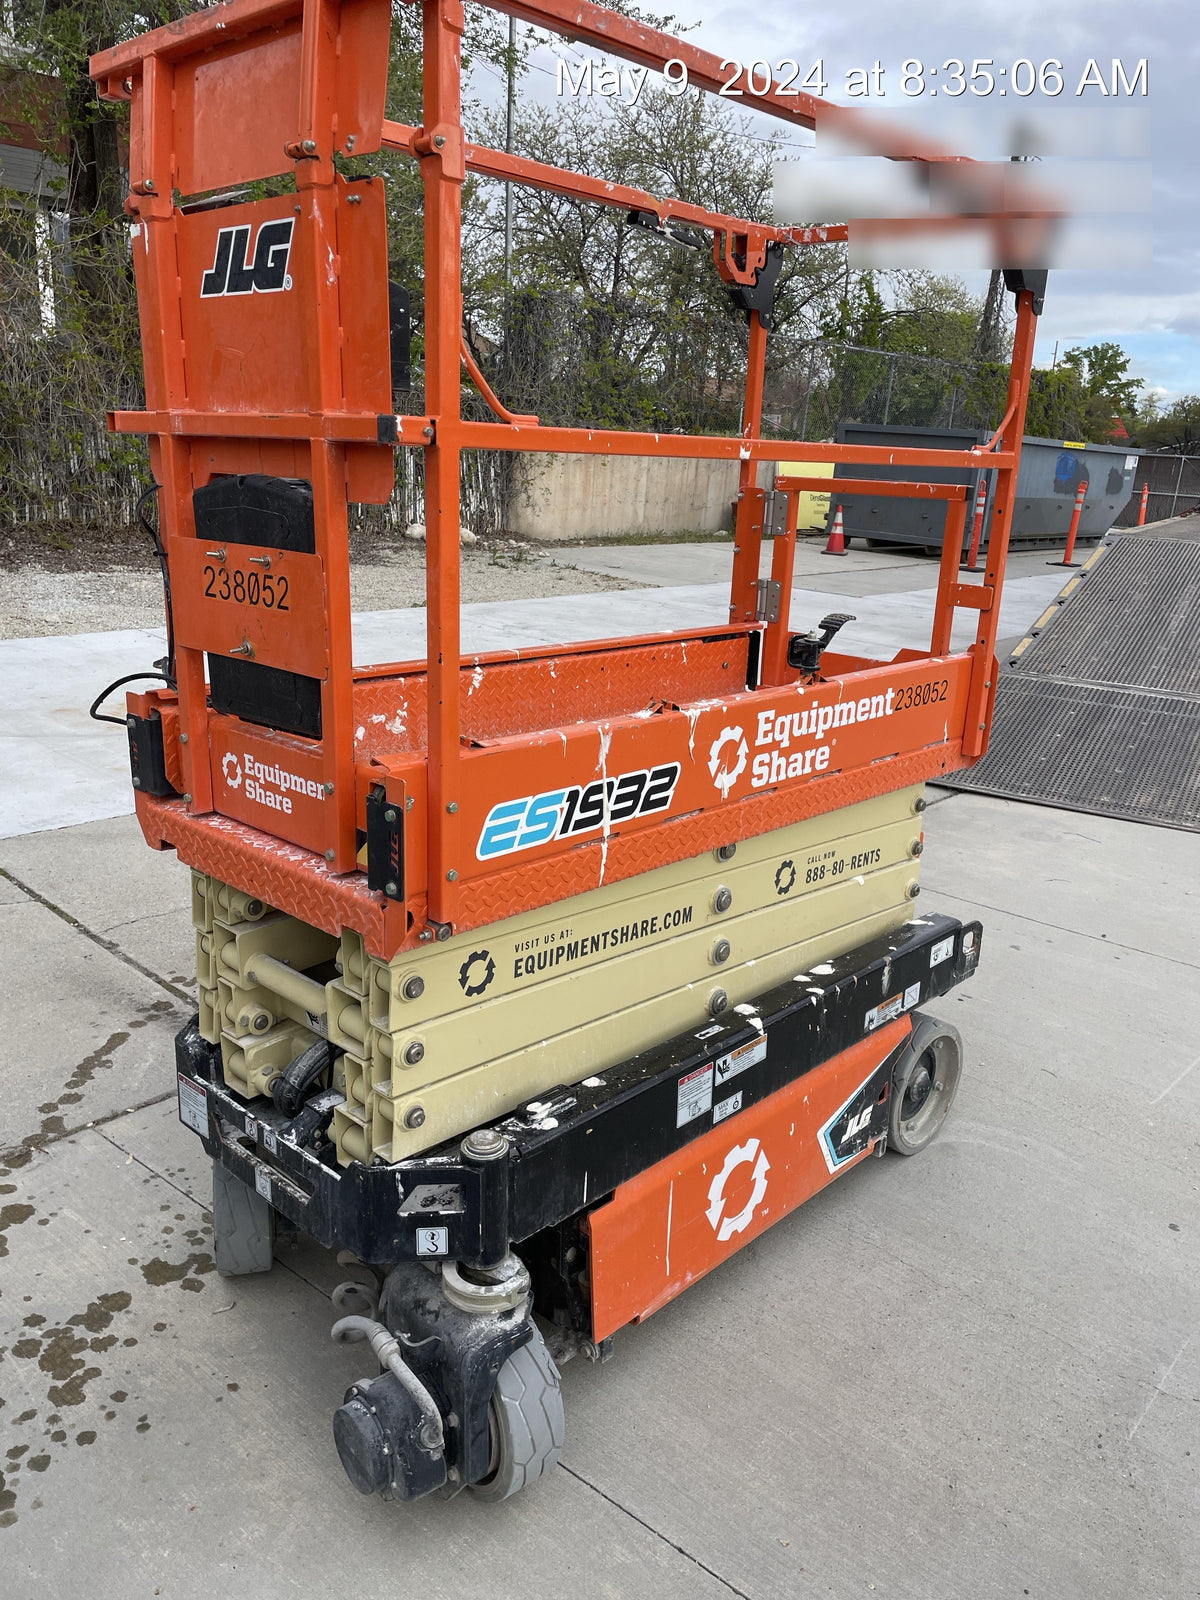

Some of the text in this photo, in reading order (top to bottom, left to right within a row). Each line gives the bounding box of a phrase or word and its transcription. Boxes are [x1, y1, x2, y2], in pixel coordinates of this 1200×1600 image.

[200, 217, 295, 298] JLG
[204, 565, 290, 612] 238052
[895, 679, 949, 712] 238052
[755, 687, 896, 748] Equipment
[243, 753, 326, 801] Equipmen
[751, 745, 830, 788] Share
[245, 778, 293, 815] Share
[477, 762, 681, 860] ES1932
[805, 848, 881, 884] 888-80-RENTS
[807, 850, 836, 865] CALL NOW
[513, 905, 693, 978] EQUIPMENTSHARE.COM
[514, 929, 573, 953] VISIT US AT:
[840, 1104, 874, 1144] JLG
